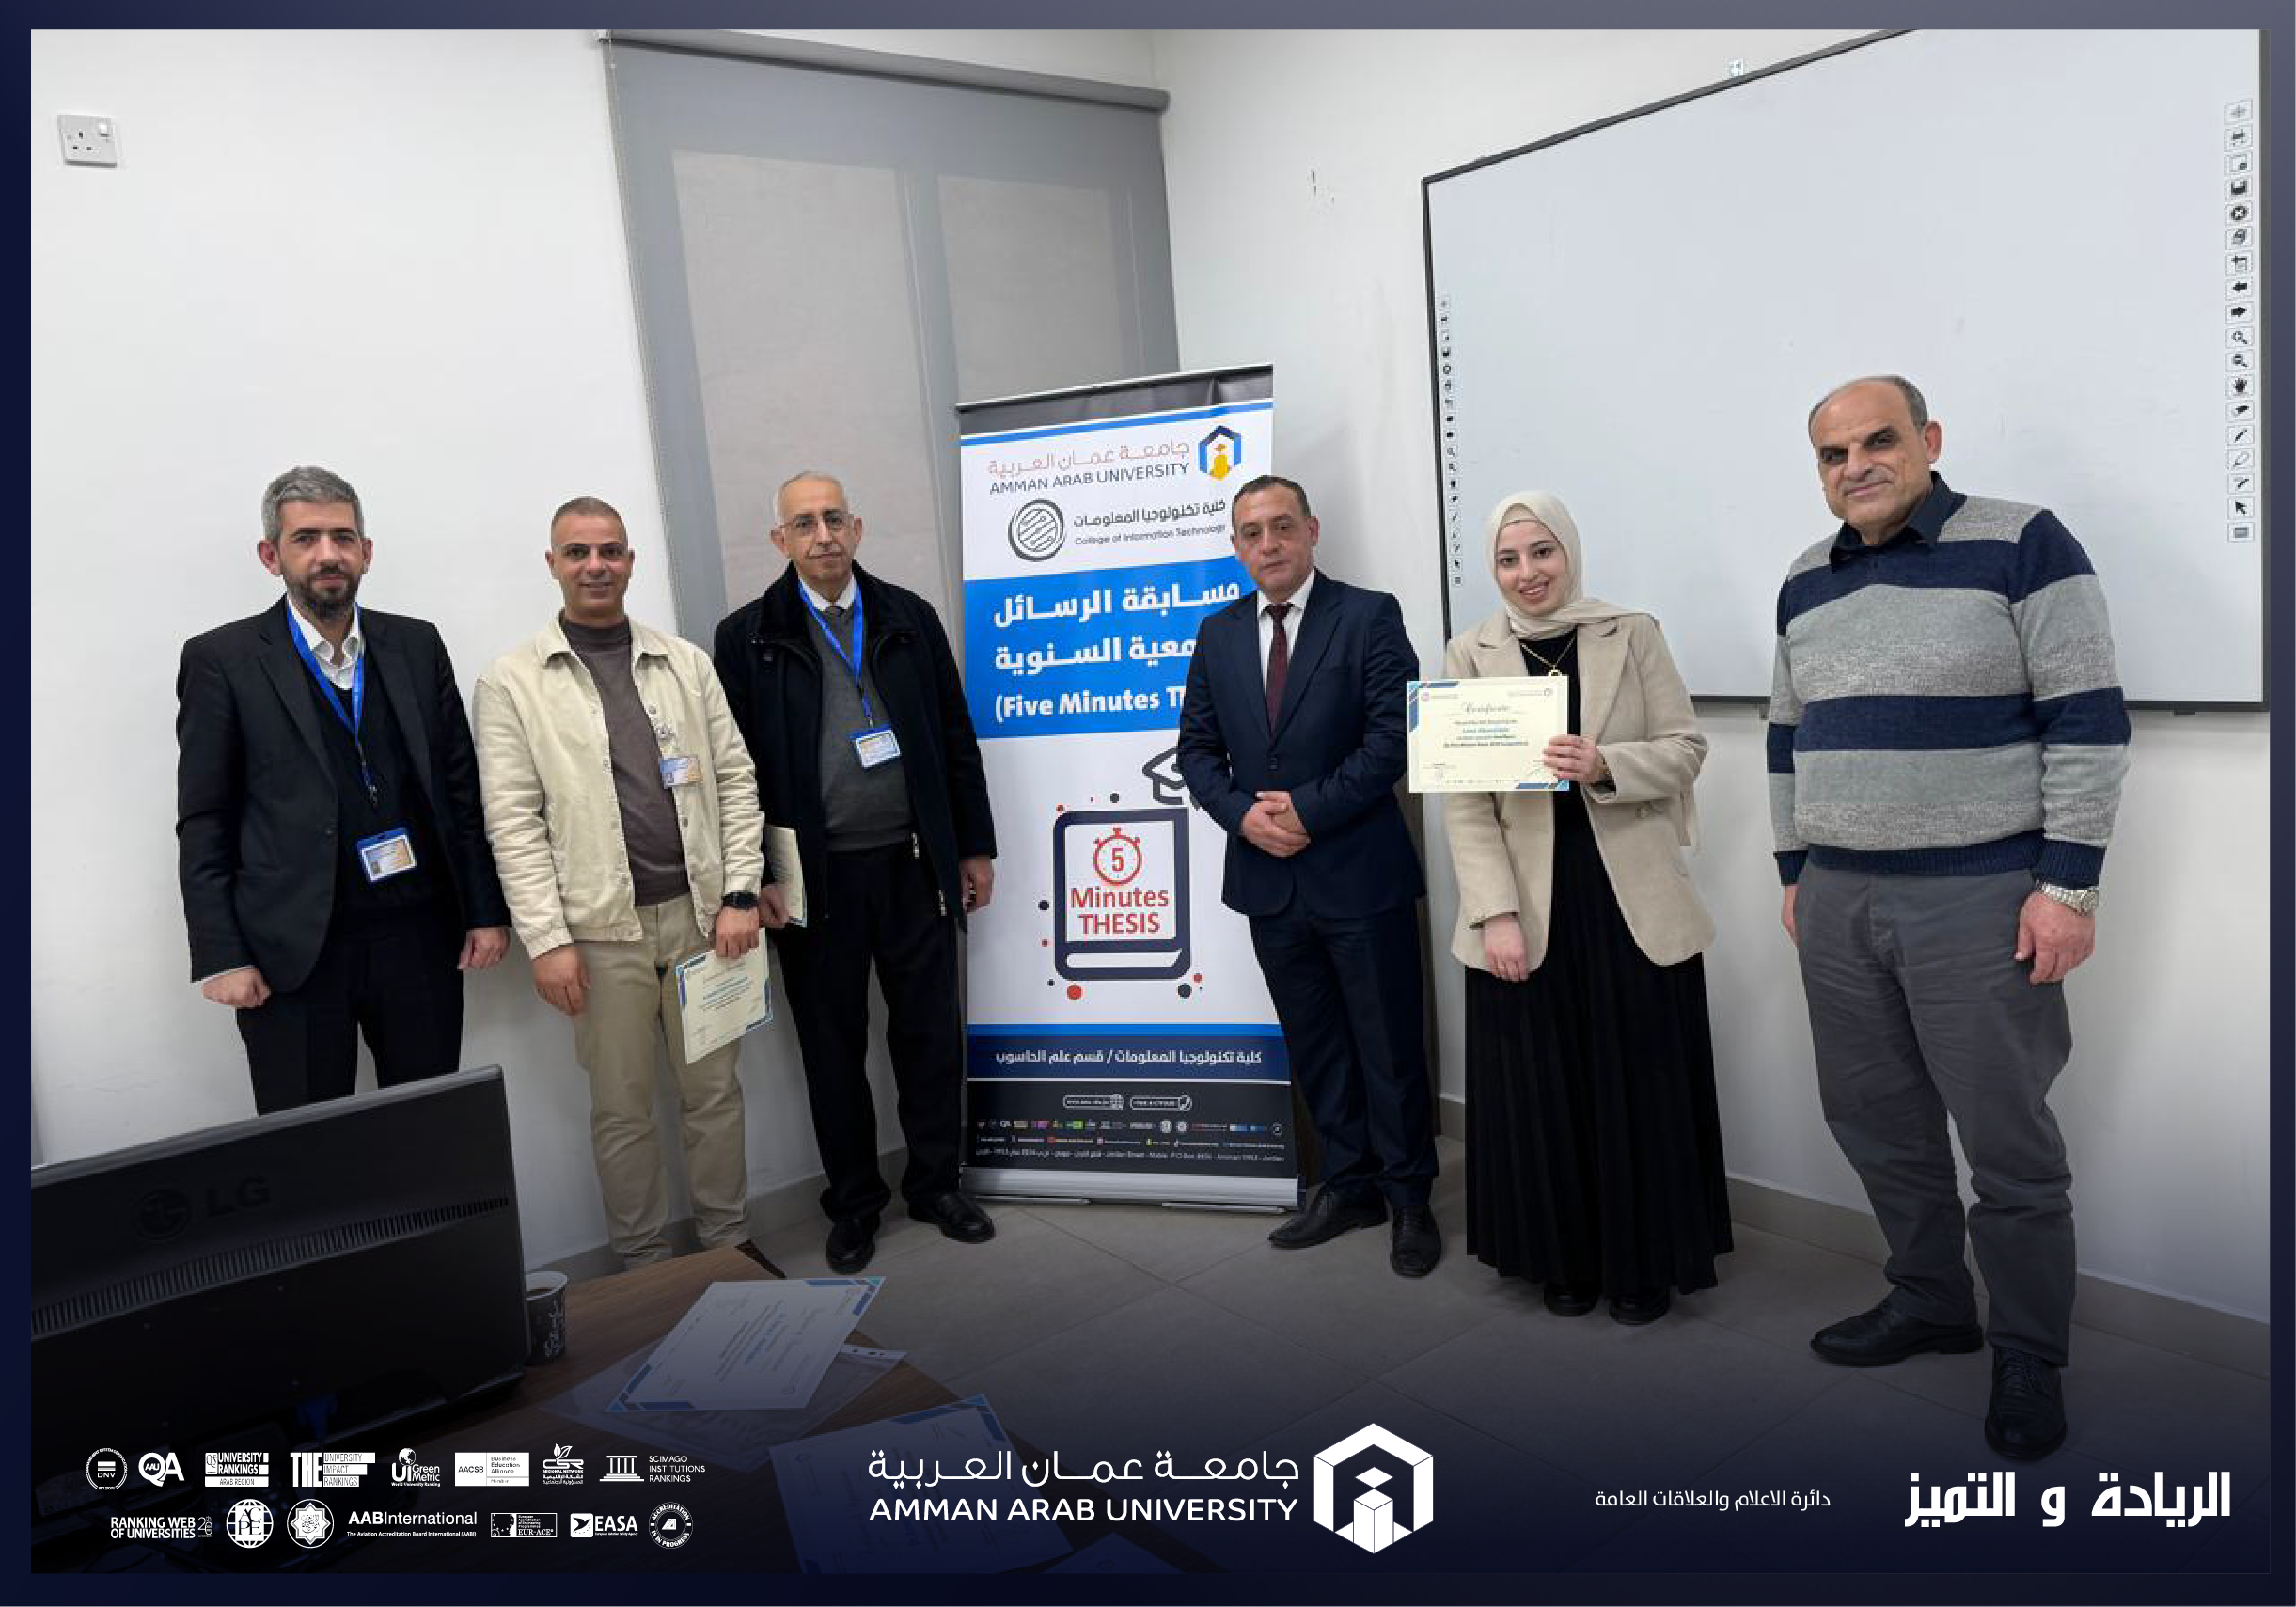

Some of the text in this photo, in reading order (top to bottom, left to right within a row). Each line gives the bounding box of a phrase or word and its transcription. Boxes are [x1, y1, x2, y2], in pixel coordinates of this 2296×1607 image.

[990, 463, 1189, 495] AMMAN ARAB UNIVERSITY
[995, 582, 1240, 628] مسابقة الرسائل
[995, 637, 1122, 676] السنوية
[995, 693, 1053, 724] (Five
[1060, 689, 1159, 715] Minutes
[1111, 848, 1124, 872] 5
[1071, 887, 1169, 908] Minutes
[1077, 912, 1161, 935] THESIS
[206, 1177, 272, 1218] LG
